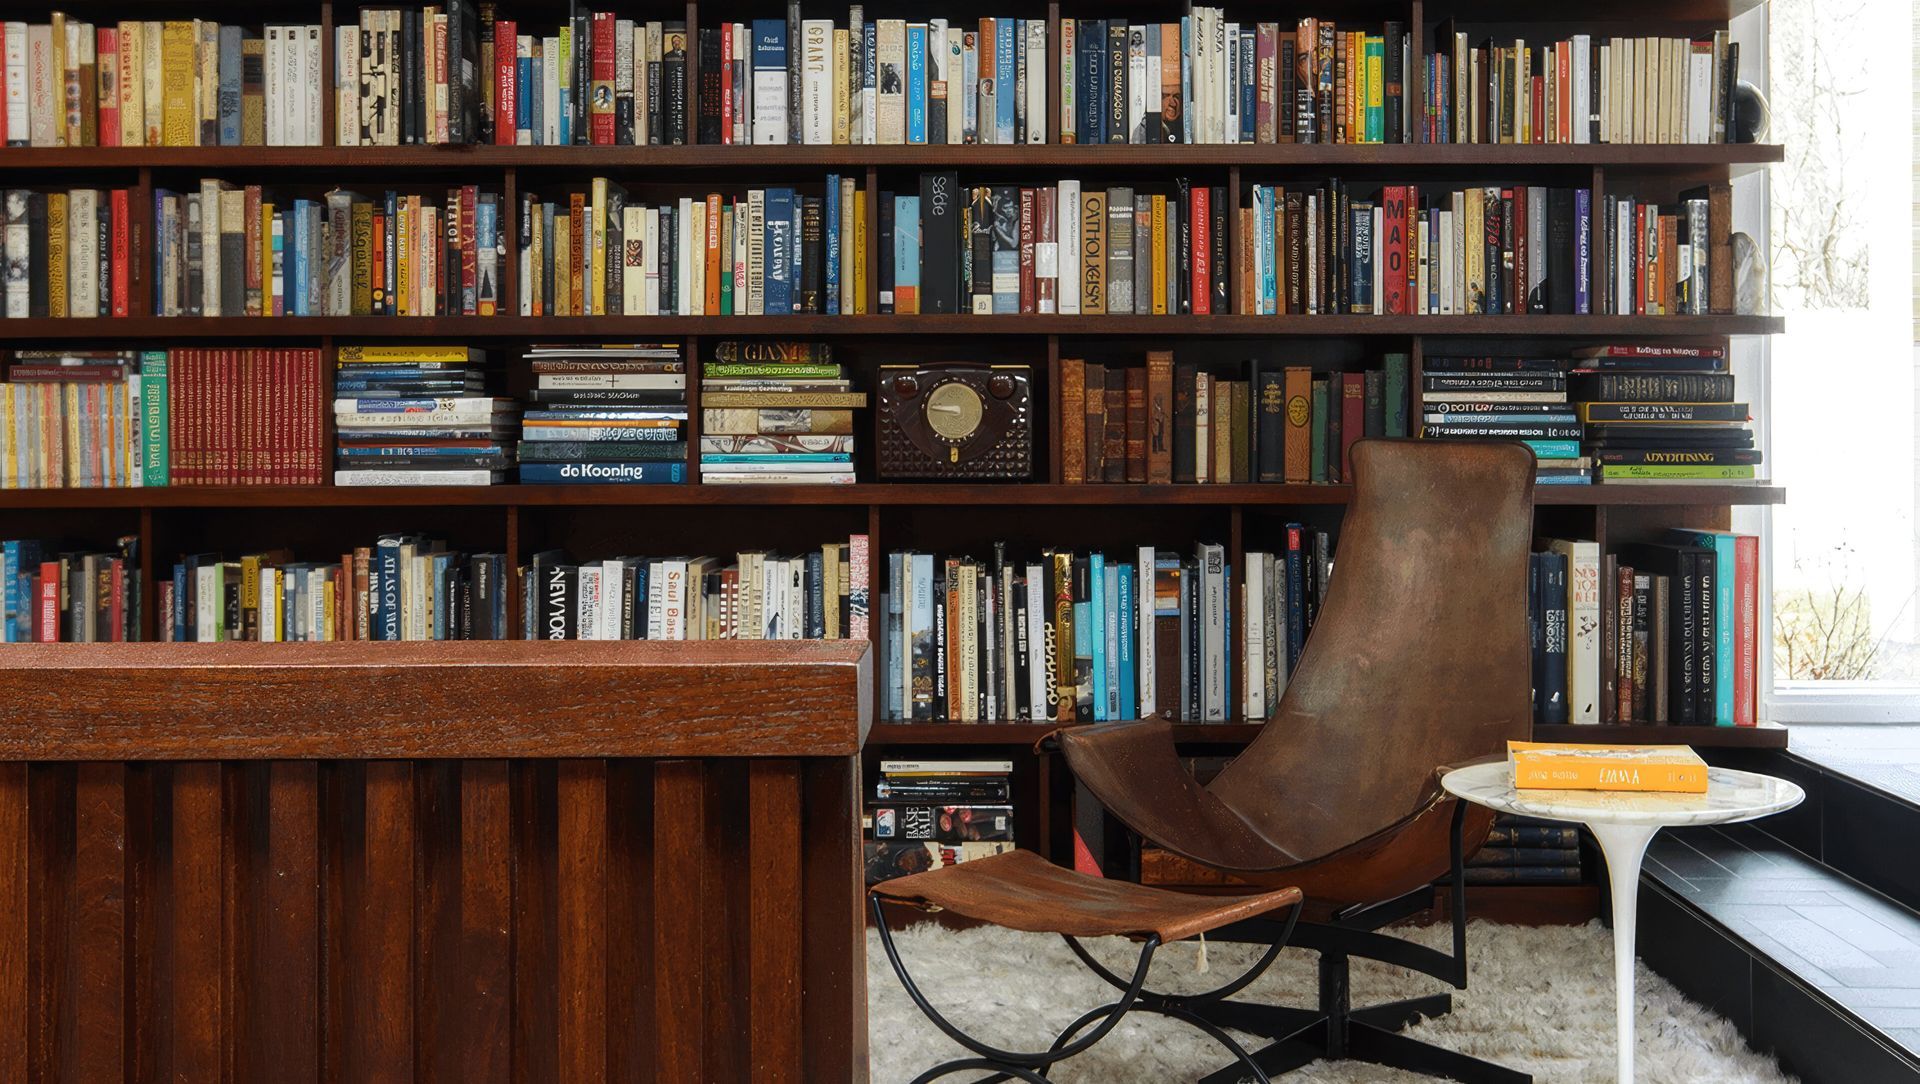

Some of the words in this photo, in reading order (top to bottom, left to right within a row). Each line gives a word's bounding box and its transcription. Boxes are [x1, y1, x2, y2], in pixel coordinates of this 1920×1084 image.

[807, 27, 824, 73] GRANT
[1085, 197, 1101, 309] CATHOLICISM
[1386, 199, 1405, 272] MAO
[384, 612, 397, 640] WOR
[549, 608, 566, 640] YOR
[1599, 768, 1640, 784] EMMA
